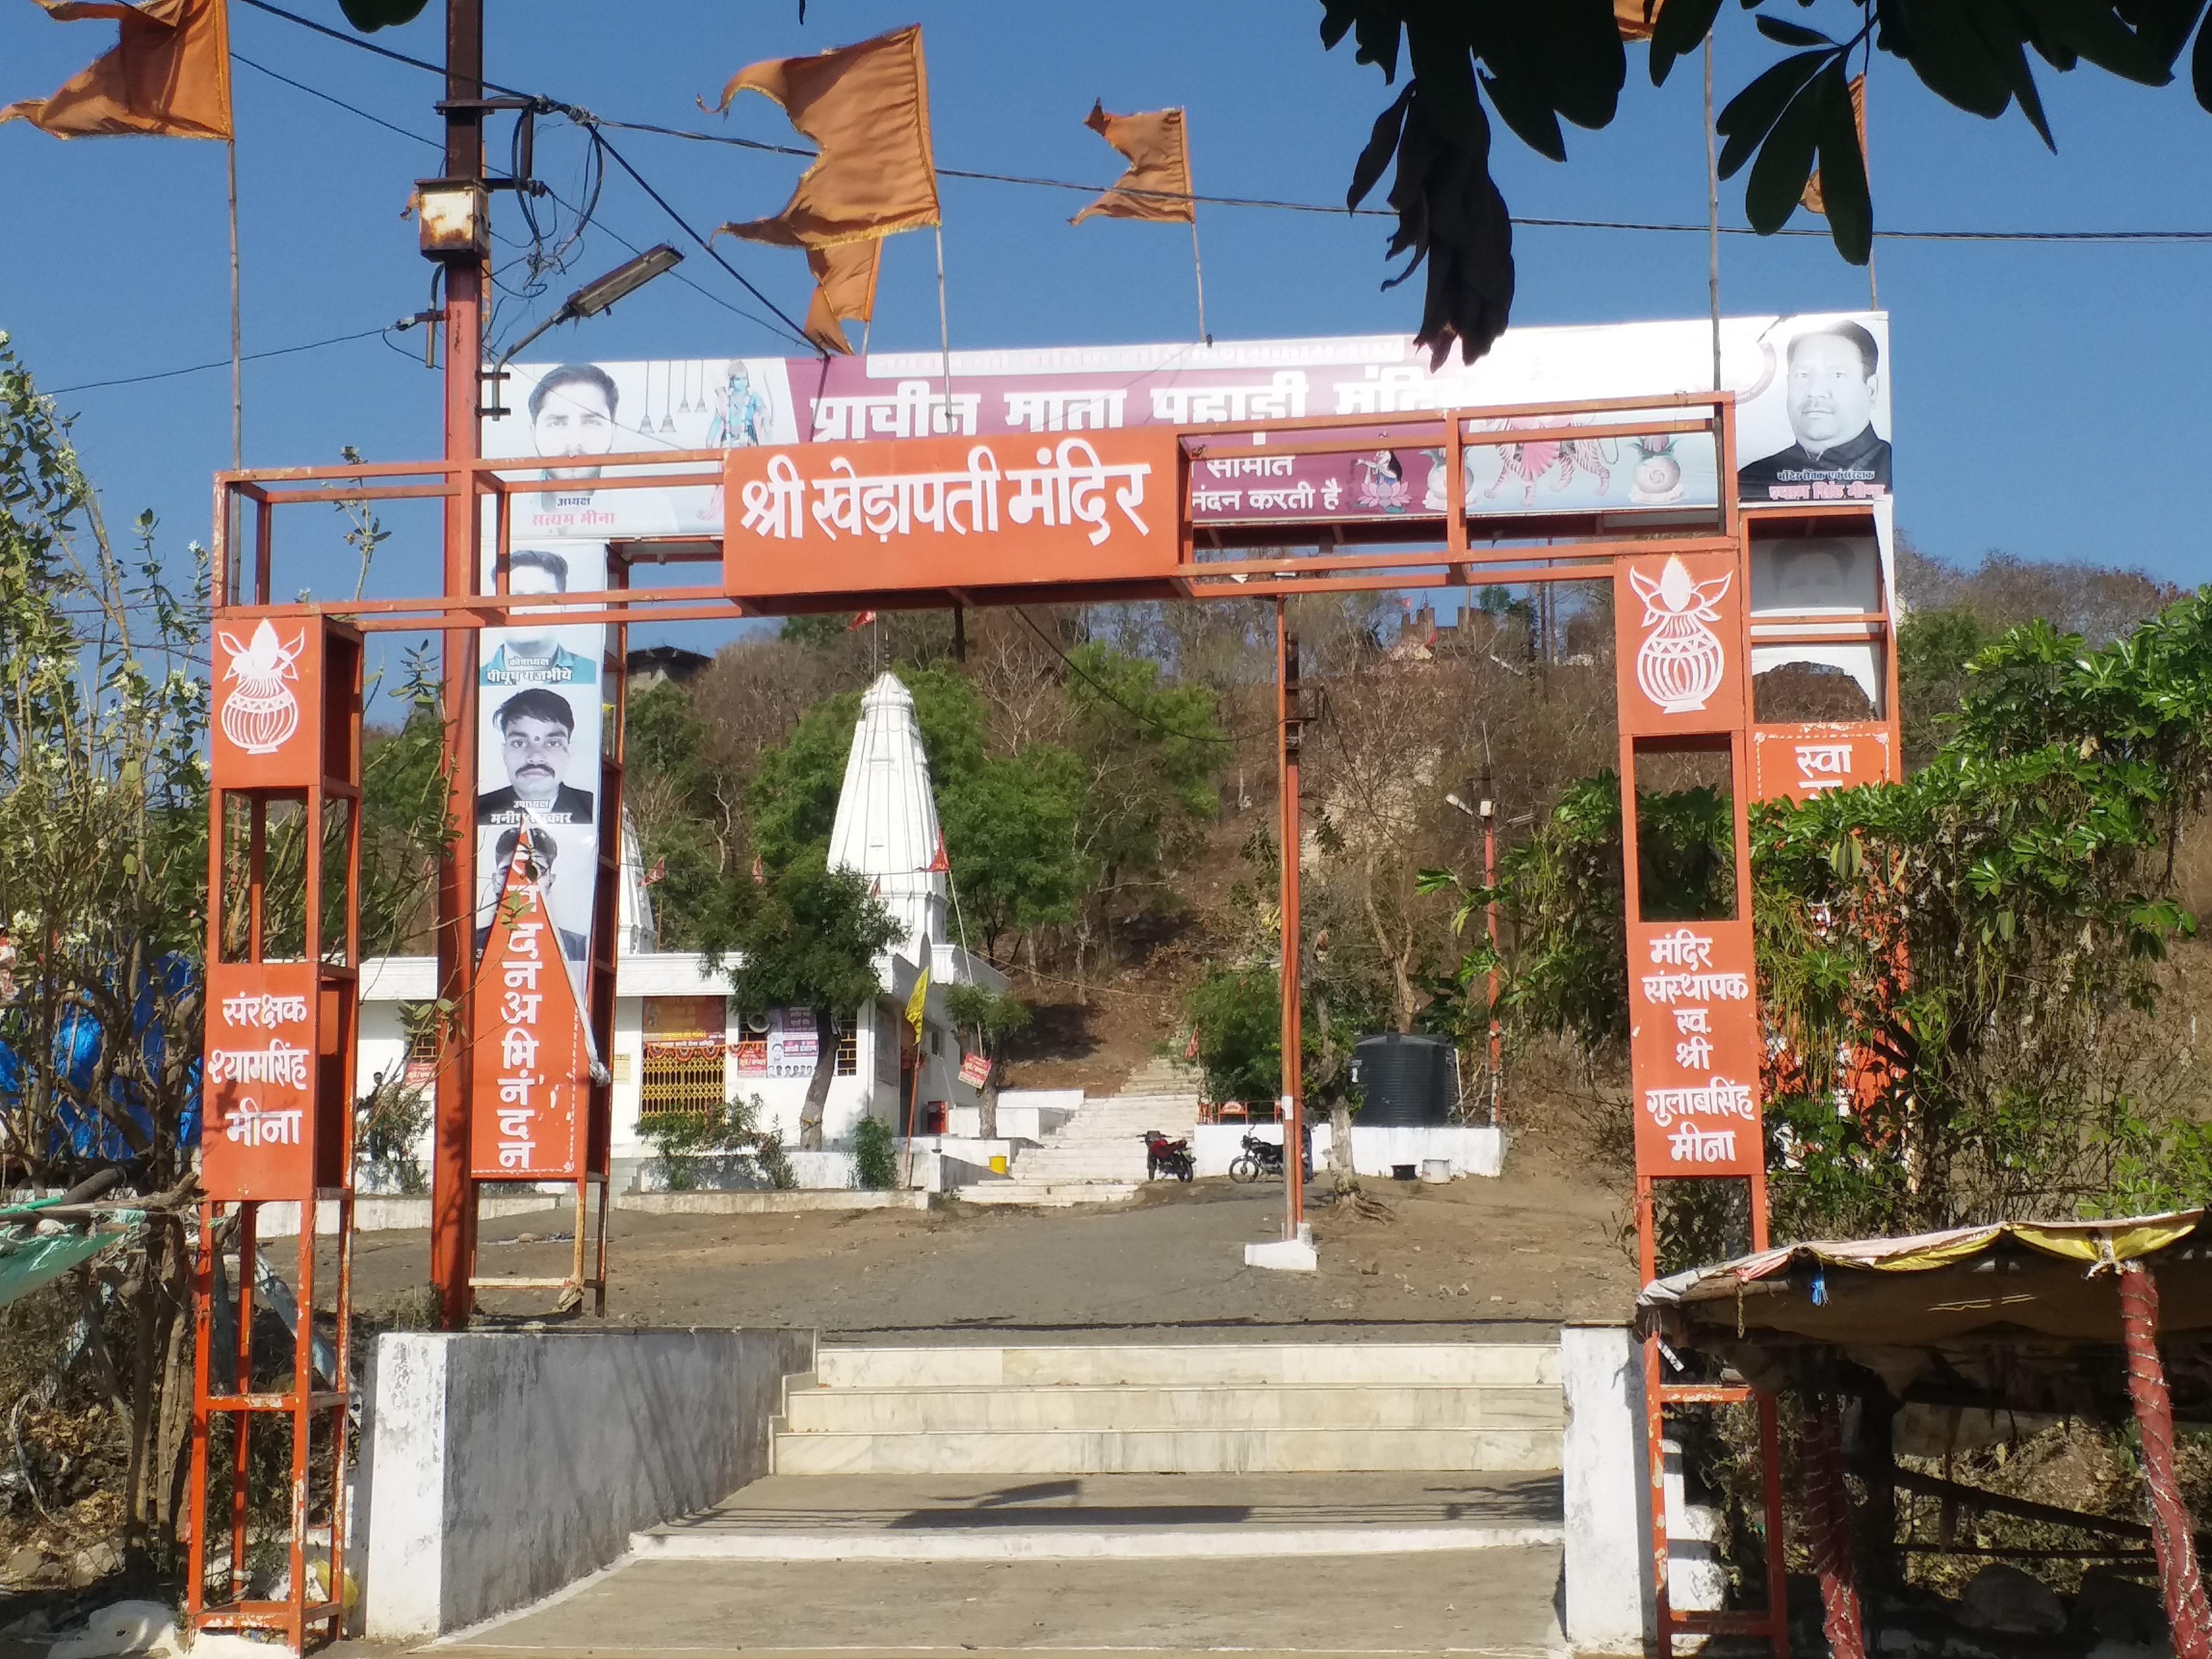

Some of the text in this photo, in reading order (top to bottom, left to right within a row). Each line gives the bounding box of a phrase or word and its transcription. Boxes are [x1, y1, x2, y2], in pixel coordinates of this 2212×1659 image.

[810, 381, 981, 442] प्राचीन
[1004, 390, 1127, 433] माता
[1333, 366, 1462, 414] मंदि
[557, 497, 591, 507] अध्यक्ष
[741, 439, 1151, 546] श्री खेड़ापती मंदिर
[1248, 481, 1316, 510] करती
[1321, 476, 1343, 510] है
[532, 509, 616, 526] सत्यम मीना
[1649, 929, 1713, 971] मंदिर
[1641, 970, 1748, 1005] संस्थापक
[222, 991, 307, 1030] संरक्षक
[1673, 1009, 1711, 1035] स्व.
[208, 1038, 309, 1090] श्यामसिंह
[1676, 1036, 1713, 1070] श्री
[1645, 1076, 1755, 1127] गुलाबसिंह
[225, 1097, 303, 1147] मीना
[1667, 1121, 1736, 1163] मीना
